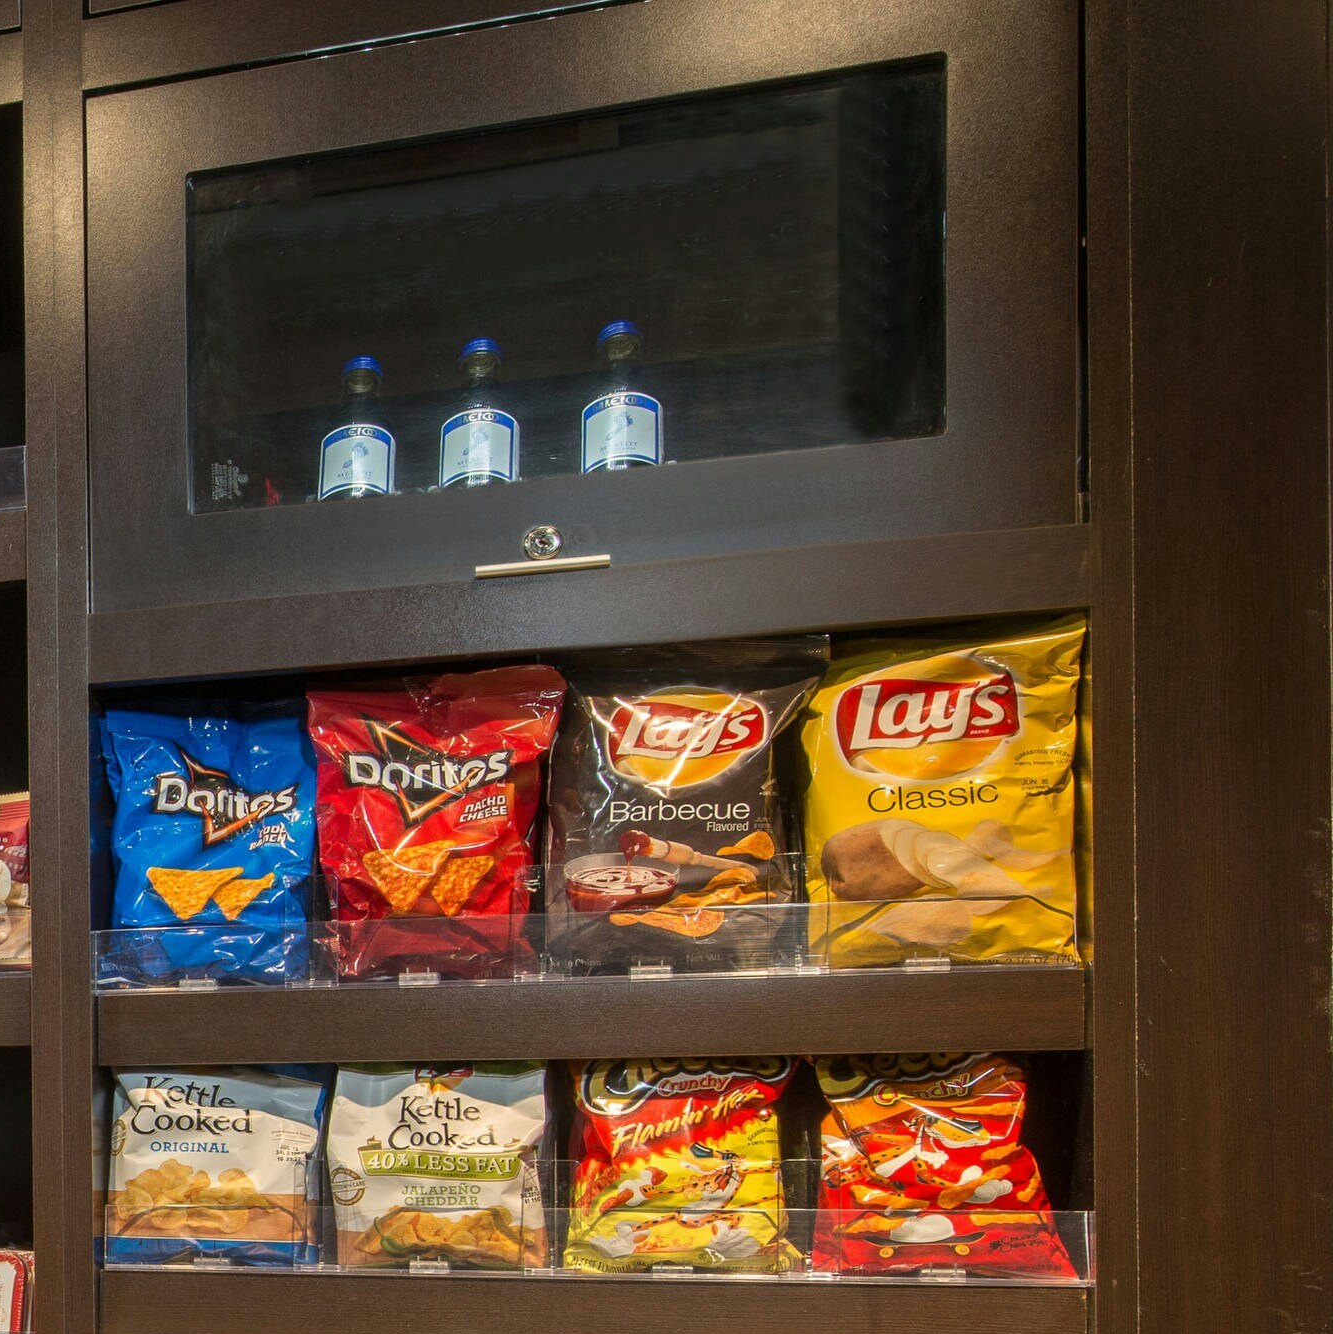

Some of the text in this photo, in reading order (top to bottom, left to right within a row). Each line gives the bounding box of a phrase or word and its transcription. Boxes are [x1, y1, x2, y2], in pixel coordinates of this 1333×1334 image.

[850, 679, 1011, 751] Lay's
[617, 704, 758, 759] Lay's
[348, 751, 510, 792] Doritos
[156, 775, 296, 819] Doritos
[867, 780, 999, 814] Classic
[459, 805, 508, 824] CHEESE
[609, 800, 750, 823] Barbecue
[706, 821, 749, 832] Flavored
[141, 1076, 236, 1109] Kettle
[658, 1076, 730, 1096] Crunchy
[131, 1105, 253, 1136] Cooked
[399, 1096, 481, 1125] Kettle
[150, 1141, 229, 1153] ORIGINAL
[388, 1123, 498, 1150] Cooked
[367, 1153, 516, 1175] 40% LESS FAT
[402, 1183, 481, 1196] JALAPEÑO
[404, 1195, 479, 1206] CHEDDAR
